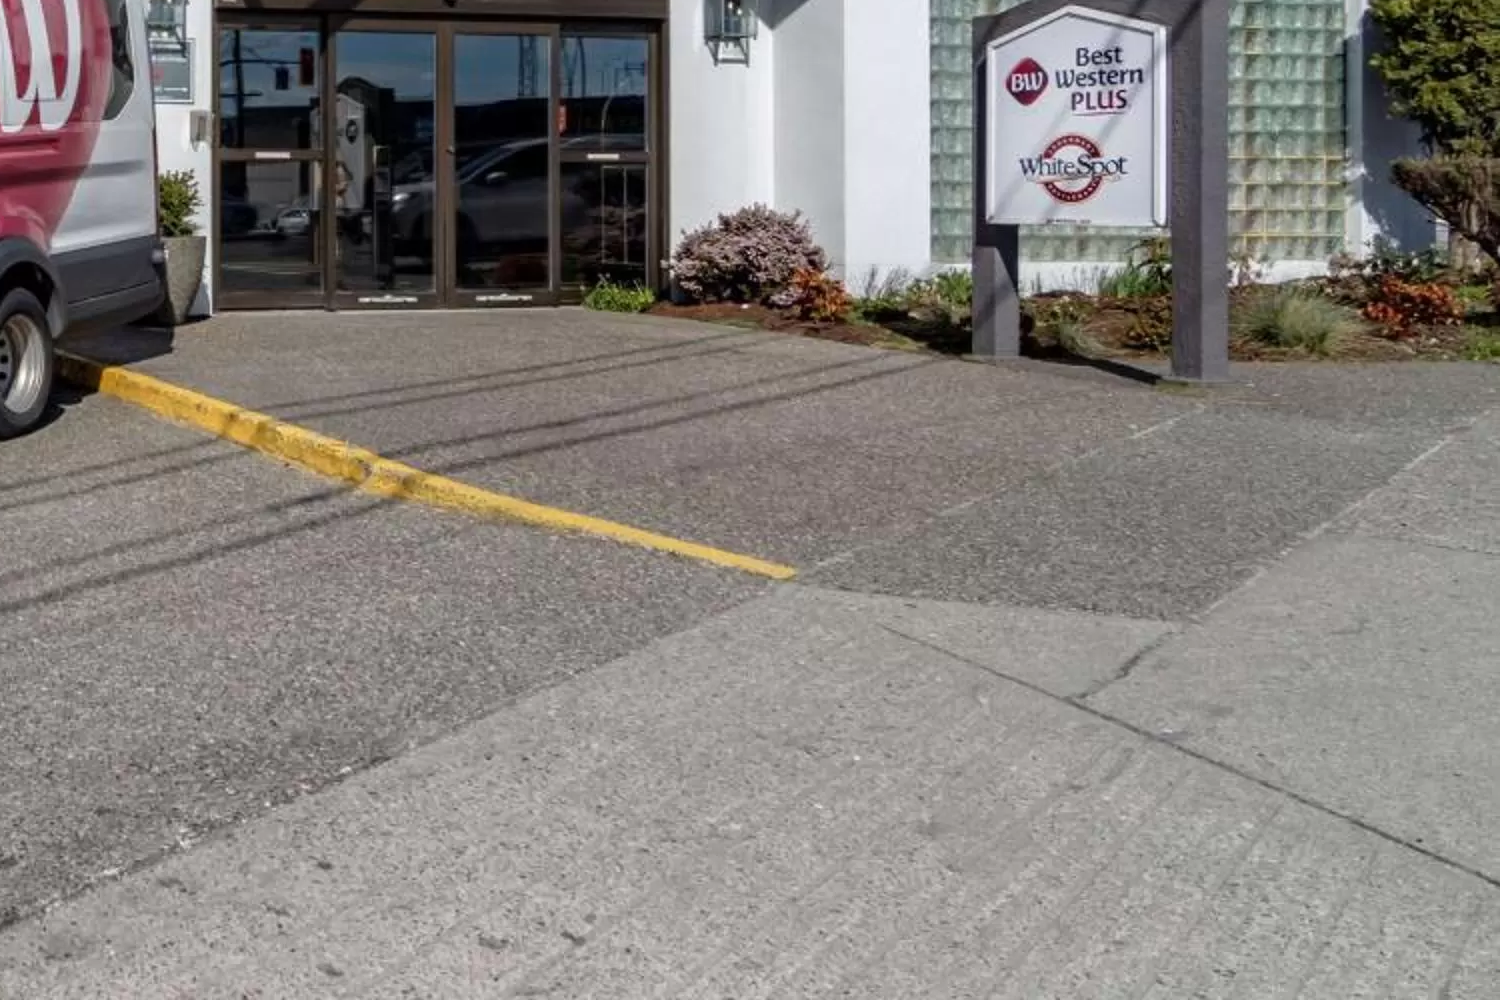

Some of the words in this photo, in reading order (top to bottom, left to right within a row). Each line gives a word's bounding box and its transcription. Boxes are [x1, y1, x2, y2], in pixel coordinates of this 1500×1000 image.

[1075, 47, 1124, 67] Best
[1010, 72, 1045, 92] BW
[1055, 66, 1144, 89] Western
[1071, 89, 1128, 110] PLUS
